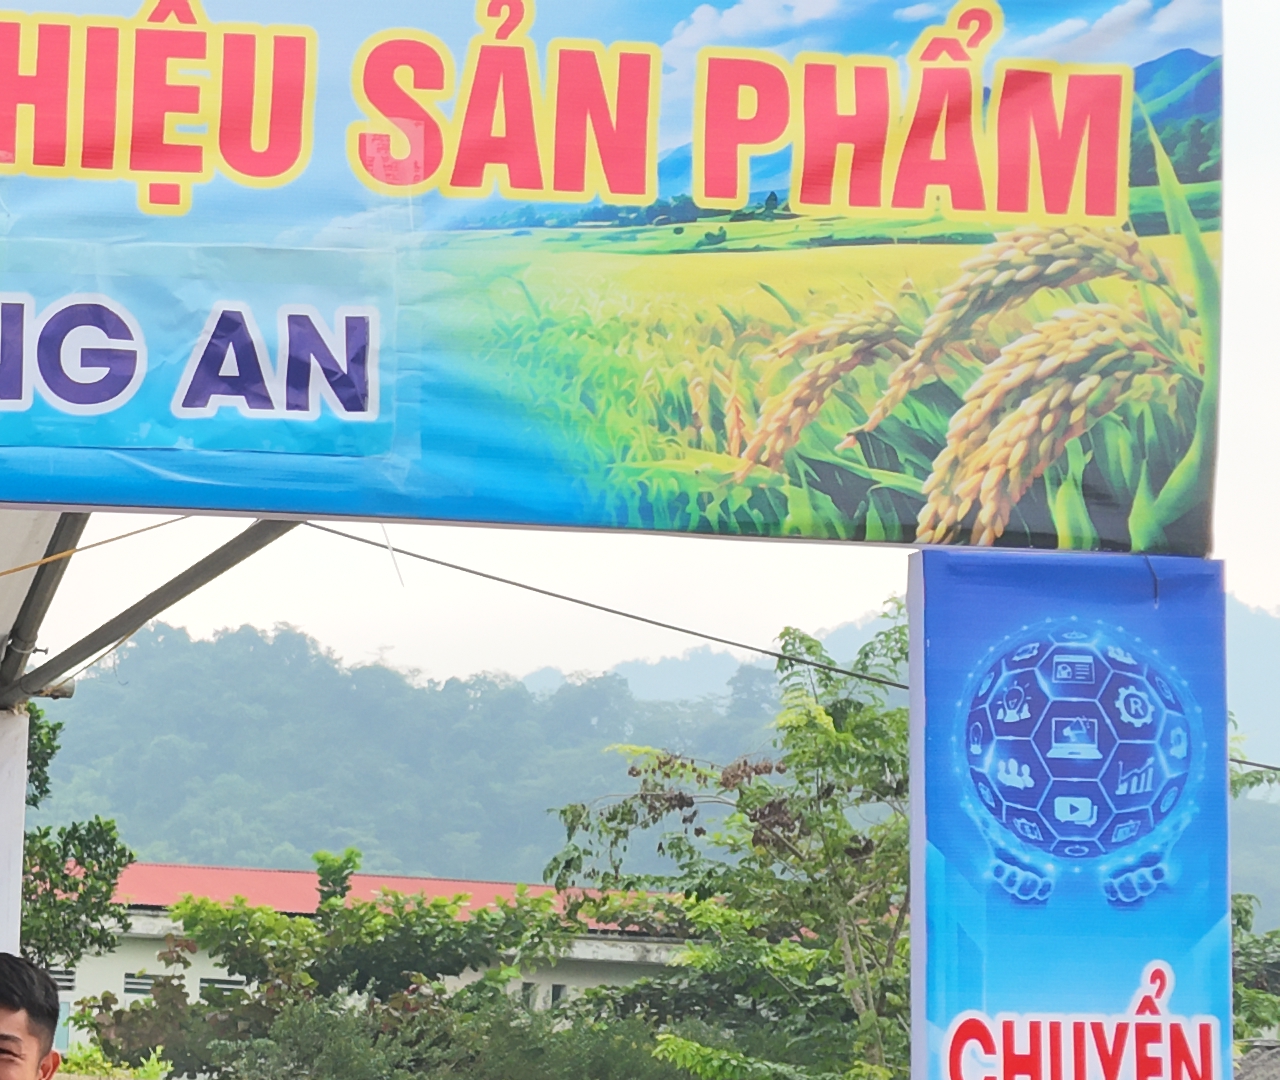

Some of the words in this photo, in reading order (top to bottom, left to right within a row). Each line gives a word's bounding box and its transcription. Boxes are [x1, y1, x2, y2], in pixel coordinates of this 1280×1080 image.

[358, 0, 652, 196] SẢN
[703, 7, 1123, 217] PHẨM
[181, 311, 369, 413] AN
